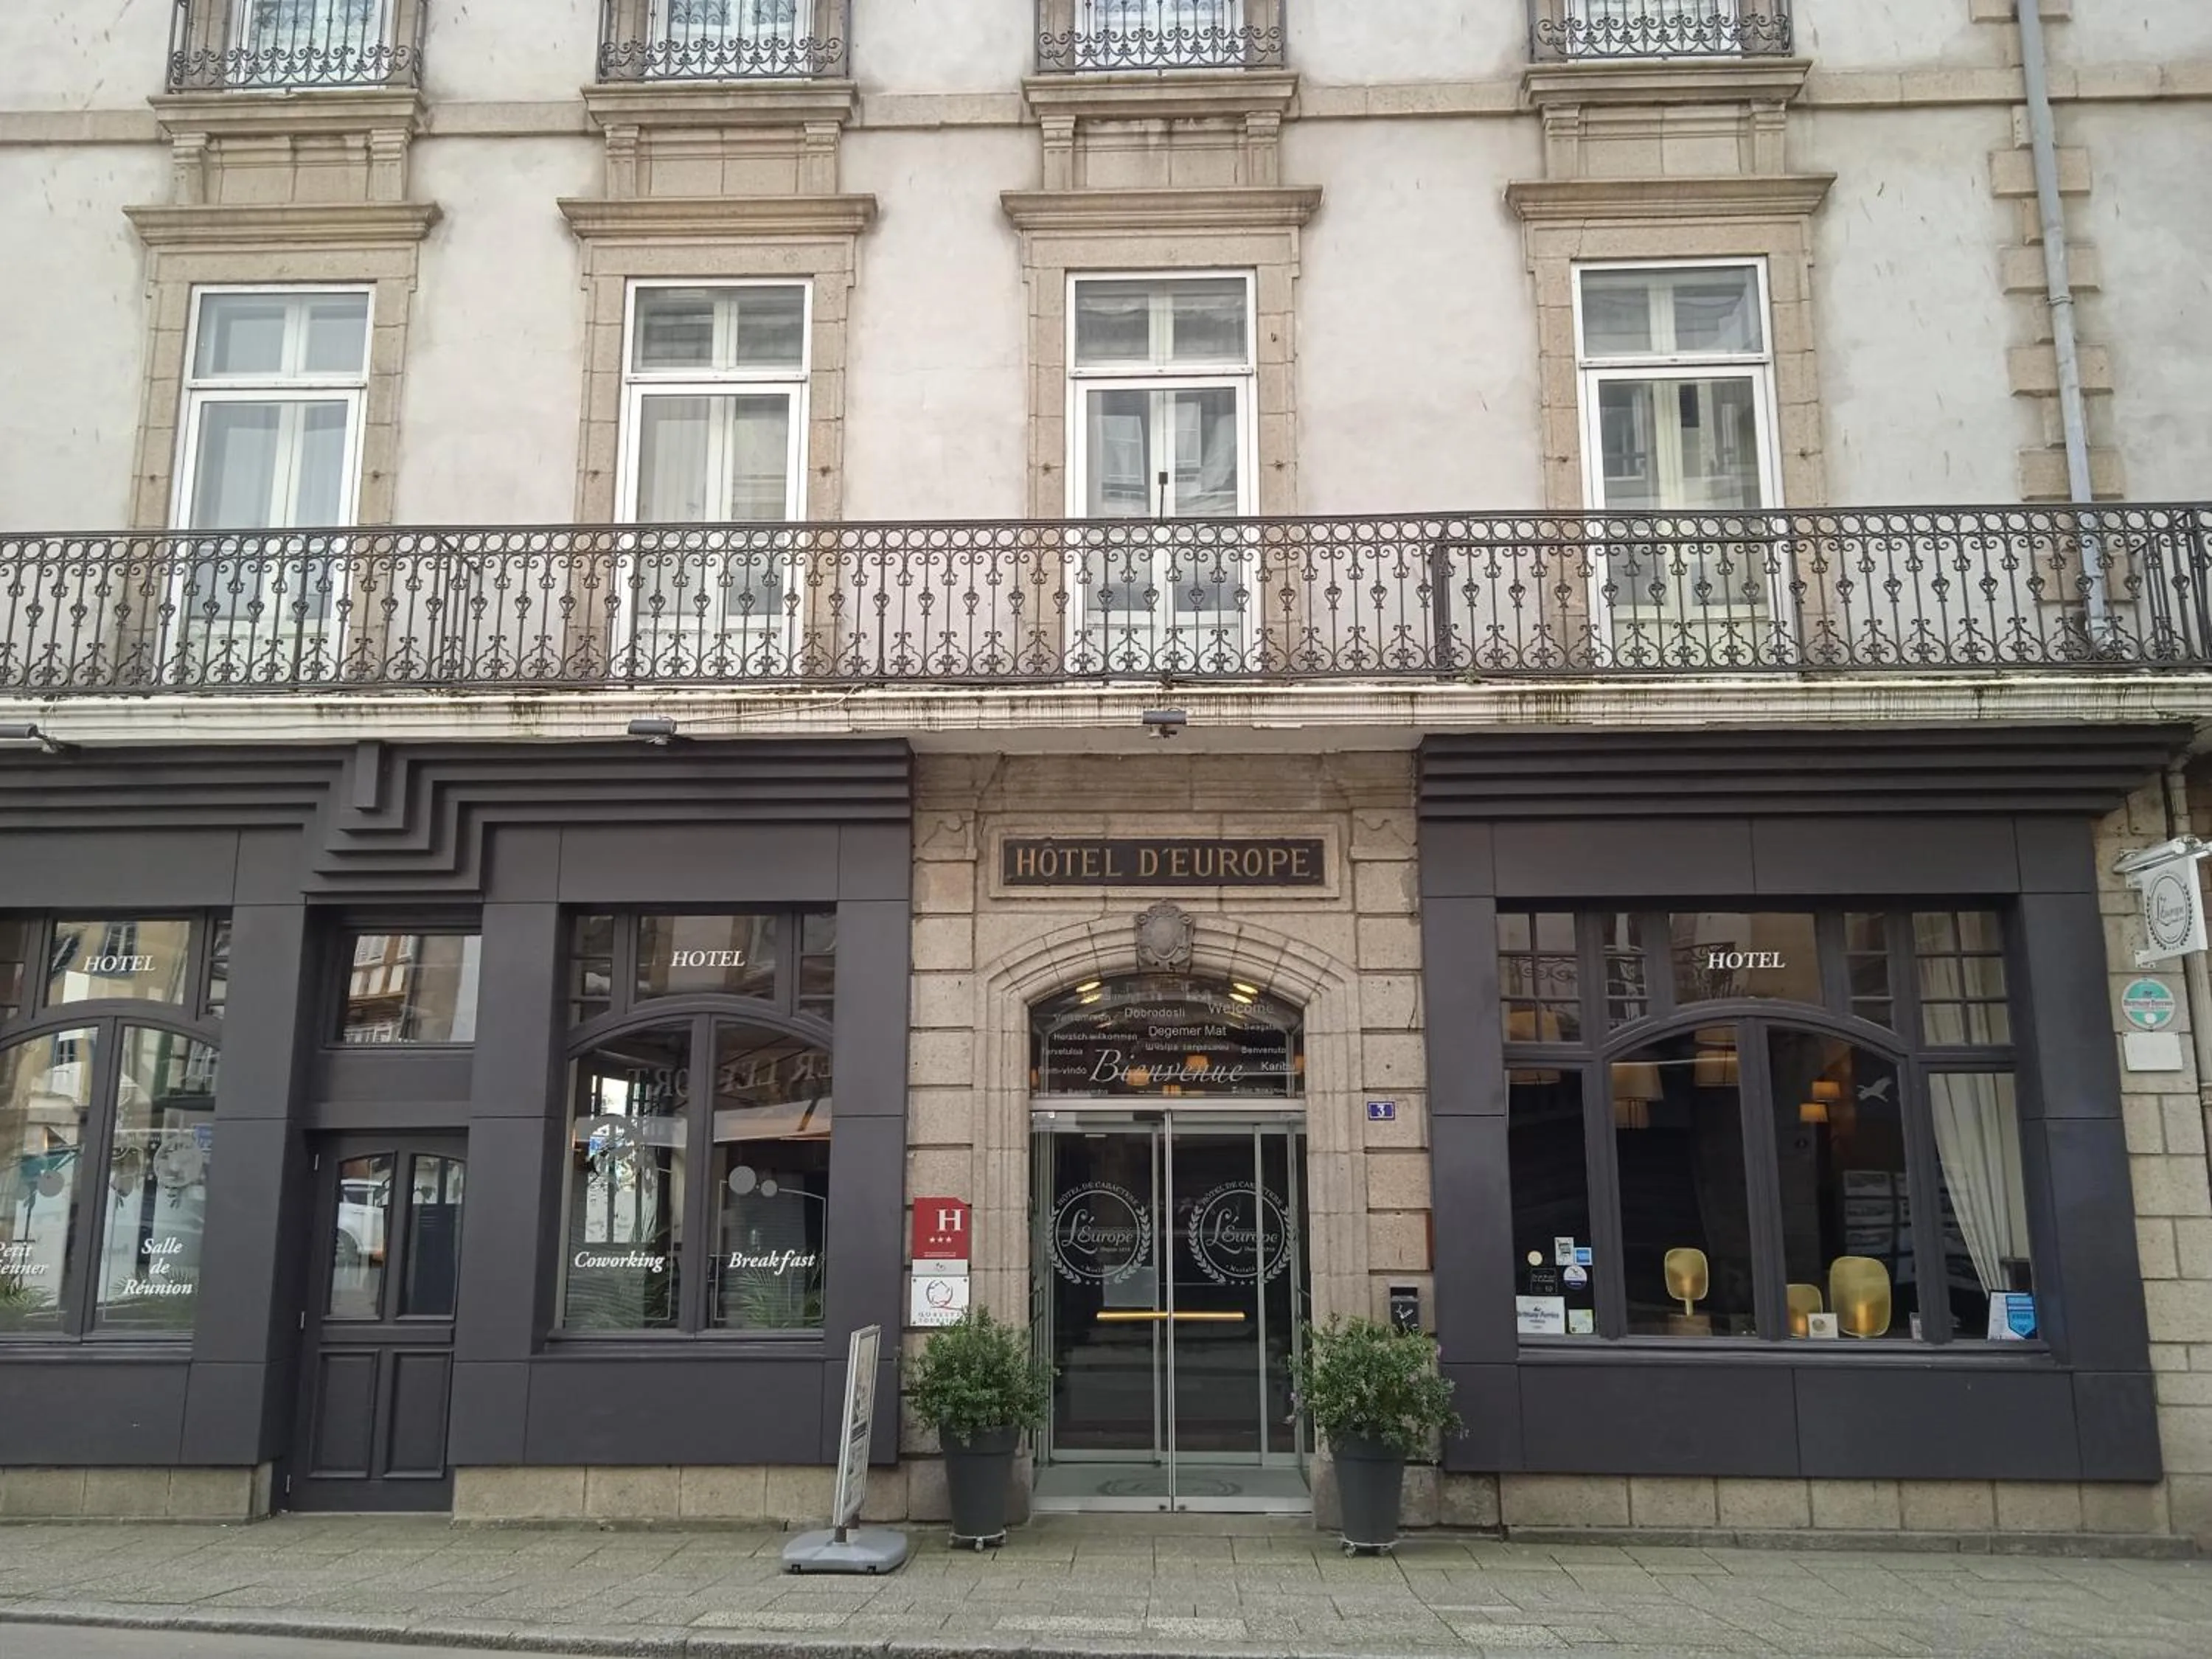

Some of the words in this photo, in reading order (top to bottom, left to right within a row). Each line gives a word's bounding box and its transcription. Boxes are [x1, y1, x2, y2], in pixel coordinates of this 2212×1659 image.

[1016, 842, 1123, 877] HÔTEL
[1139, 847, 1311, 877] D'EUROPE
[83, 955, 156, 972] HOTEL
[670, 950, 745, 967] HOTEL
[1708, 952, 1786, 969] HOTEL
[1149, 1026, 1201, 1038] Degemer
[1205, 1025, 1227, 1037] Mat
[1088, 1048, 1246, 1083] Bienvenue
[1377, 1105, 1385, 1116] 3
[937, 1208, 964, 1231] H
[141, 1237, 184, 1254] Salle
[149, 1257, 171, 1275] de
[574, 1251, 666, 1273] Coworking
[728, 1250, 815, 1275] Breakfast
[122, 1278, 193, 1295] Réunion
